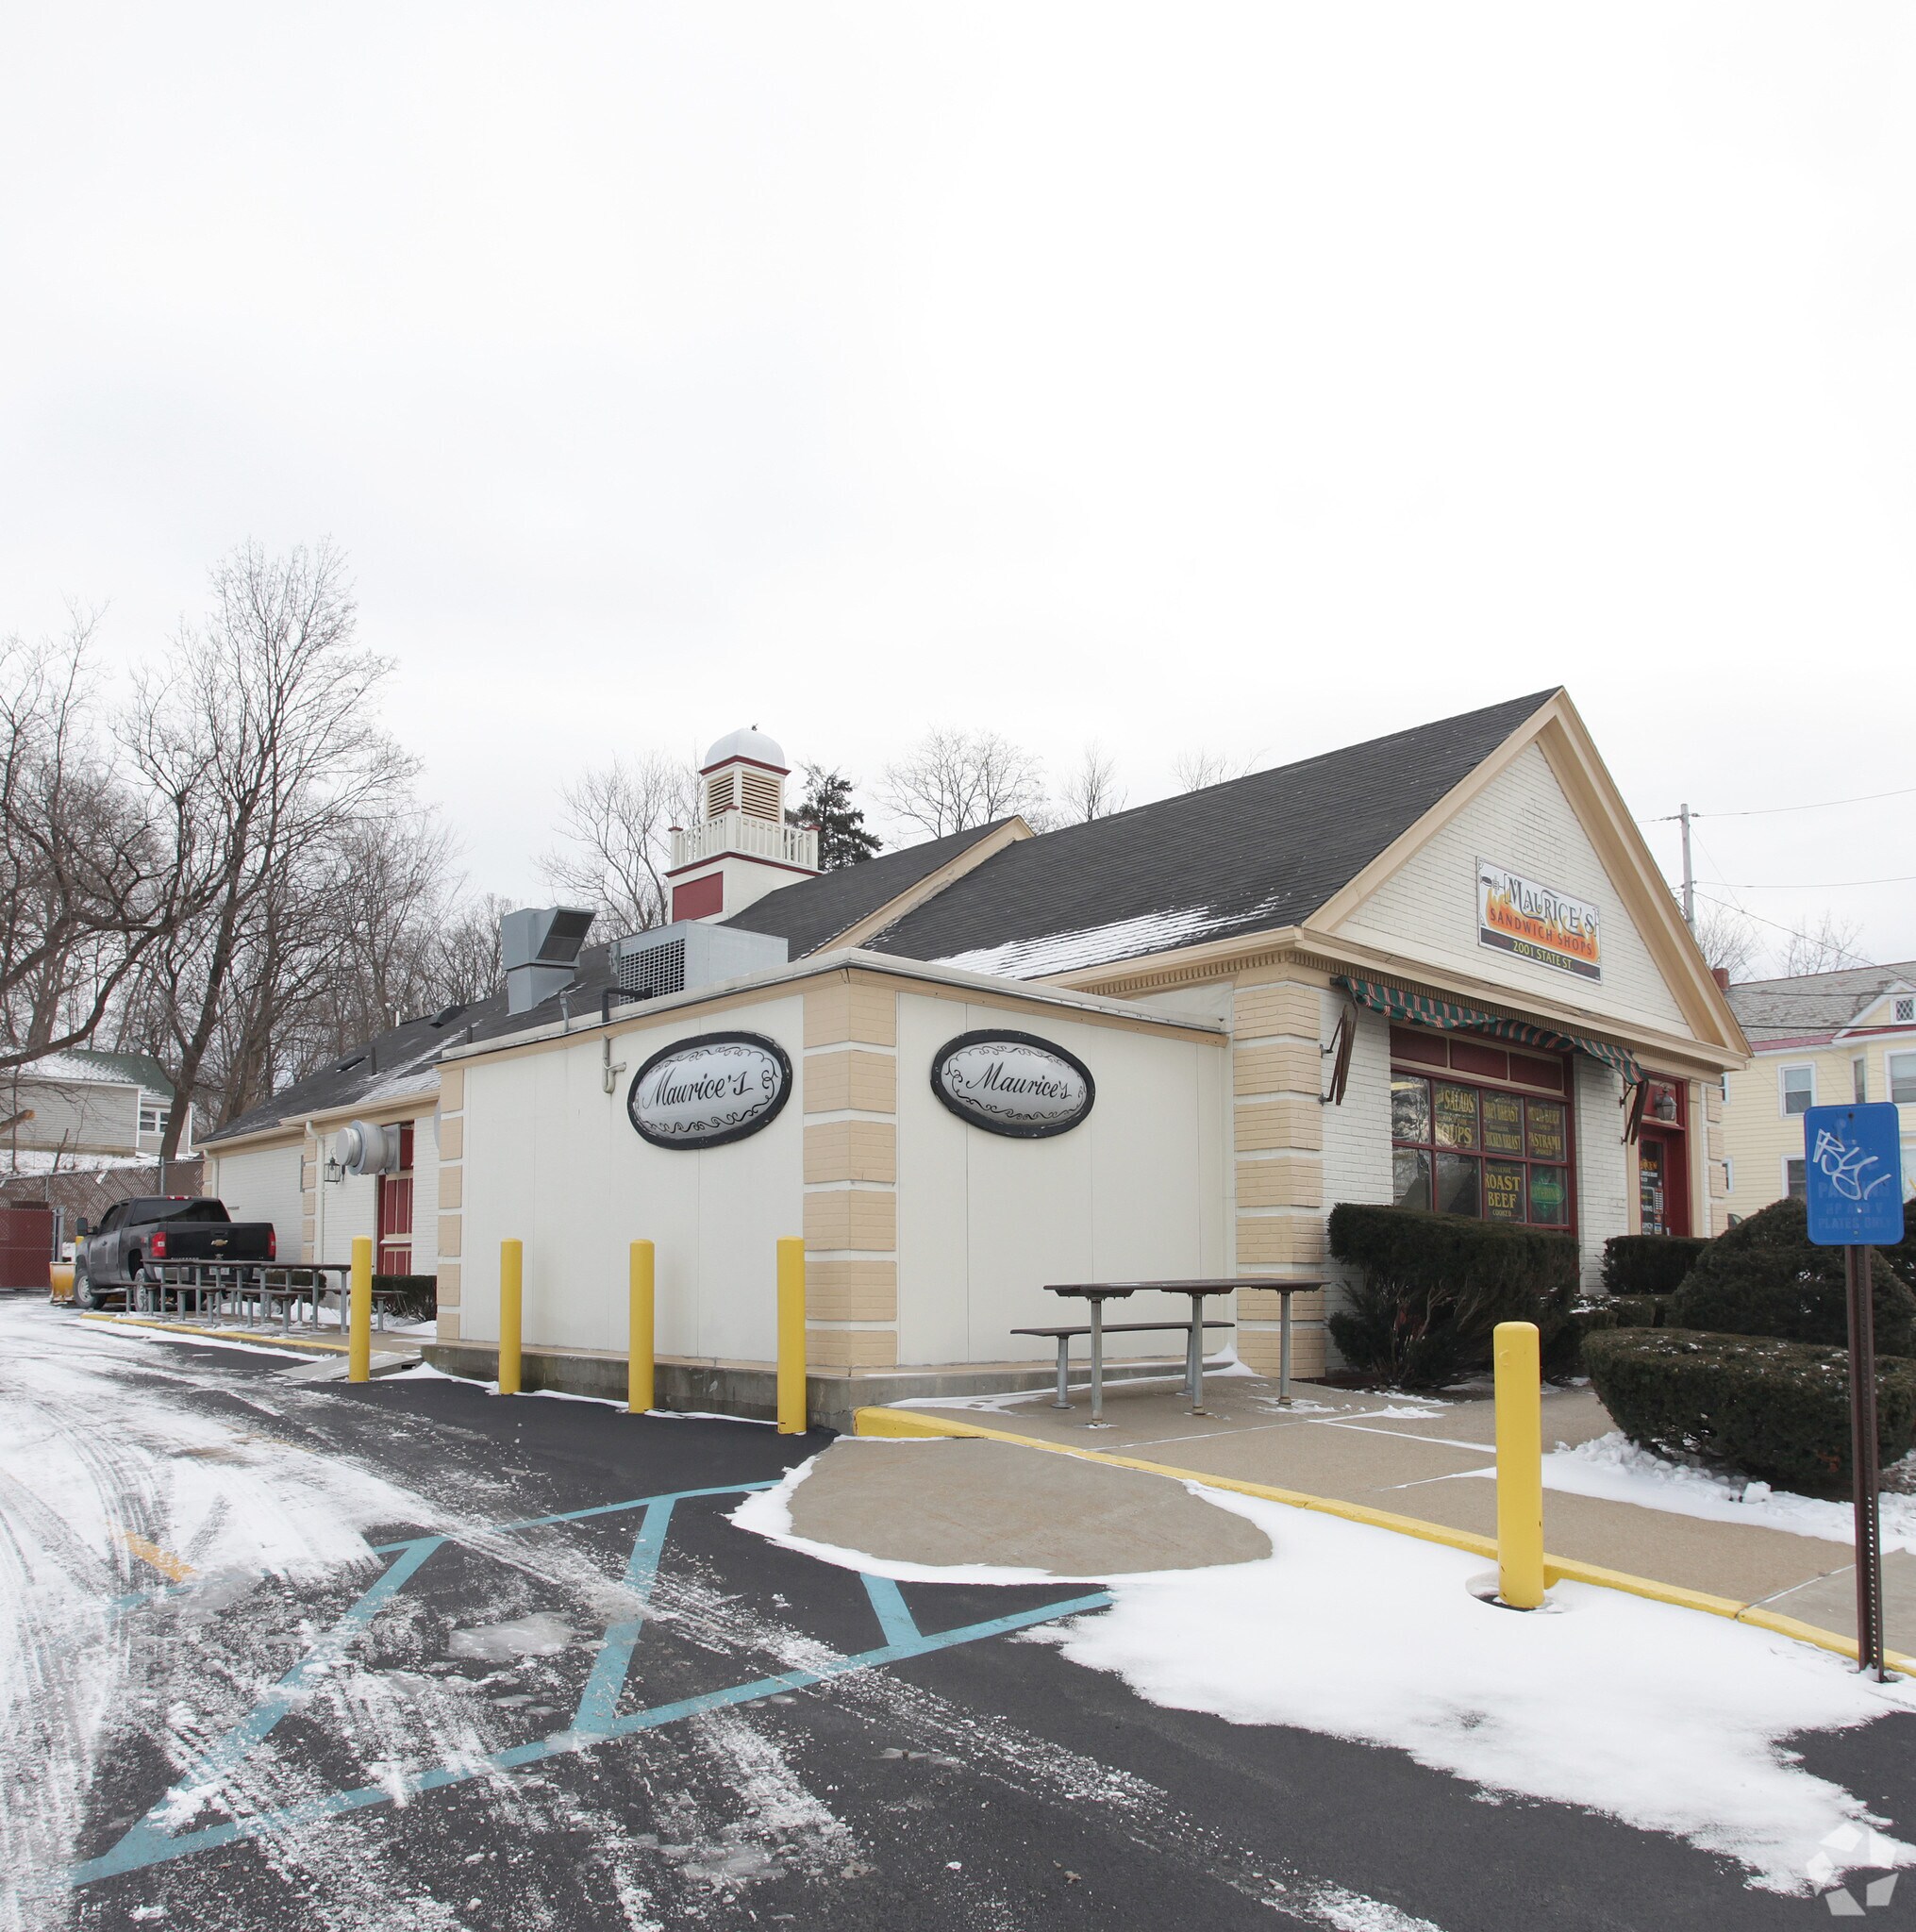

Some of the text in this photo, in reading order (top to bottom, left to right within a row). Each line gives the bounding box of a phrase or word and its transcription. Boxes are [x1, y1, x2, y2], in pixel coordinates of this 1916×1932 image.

[1490, 908, 1592, 956] SANDWICH SHOPS
[1513, 941, 1574, 971] 2001 STATE ST.
[966, 1061, 1072, 1099] Maurice's
[1444, 1090, 1474, 1114] SALADS
[1485, 1174, 1522, 1191] ROAST
[1488, 1192, 1517, 1208] BEEF
